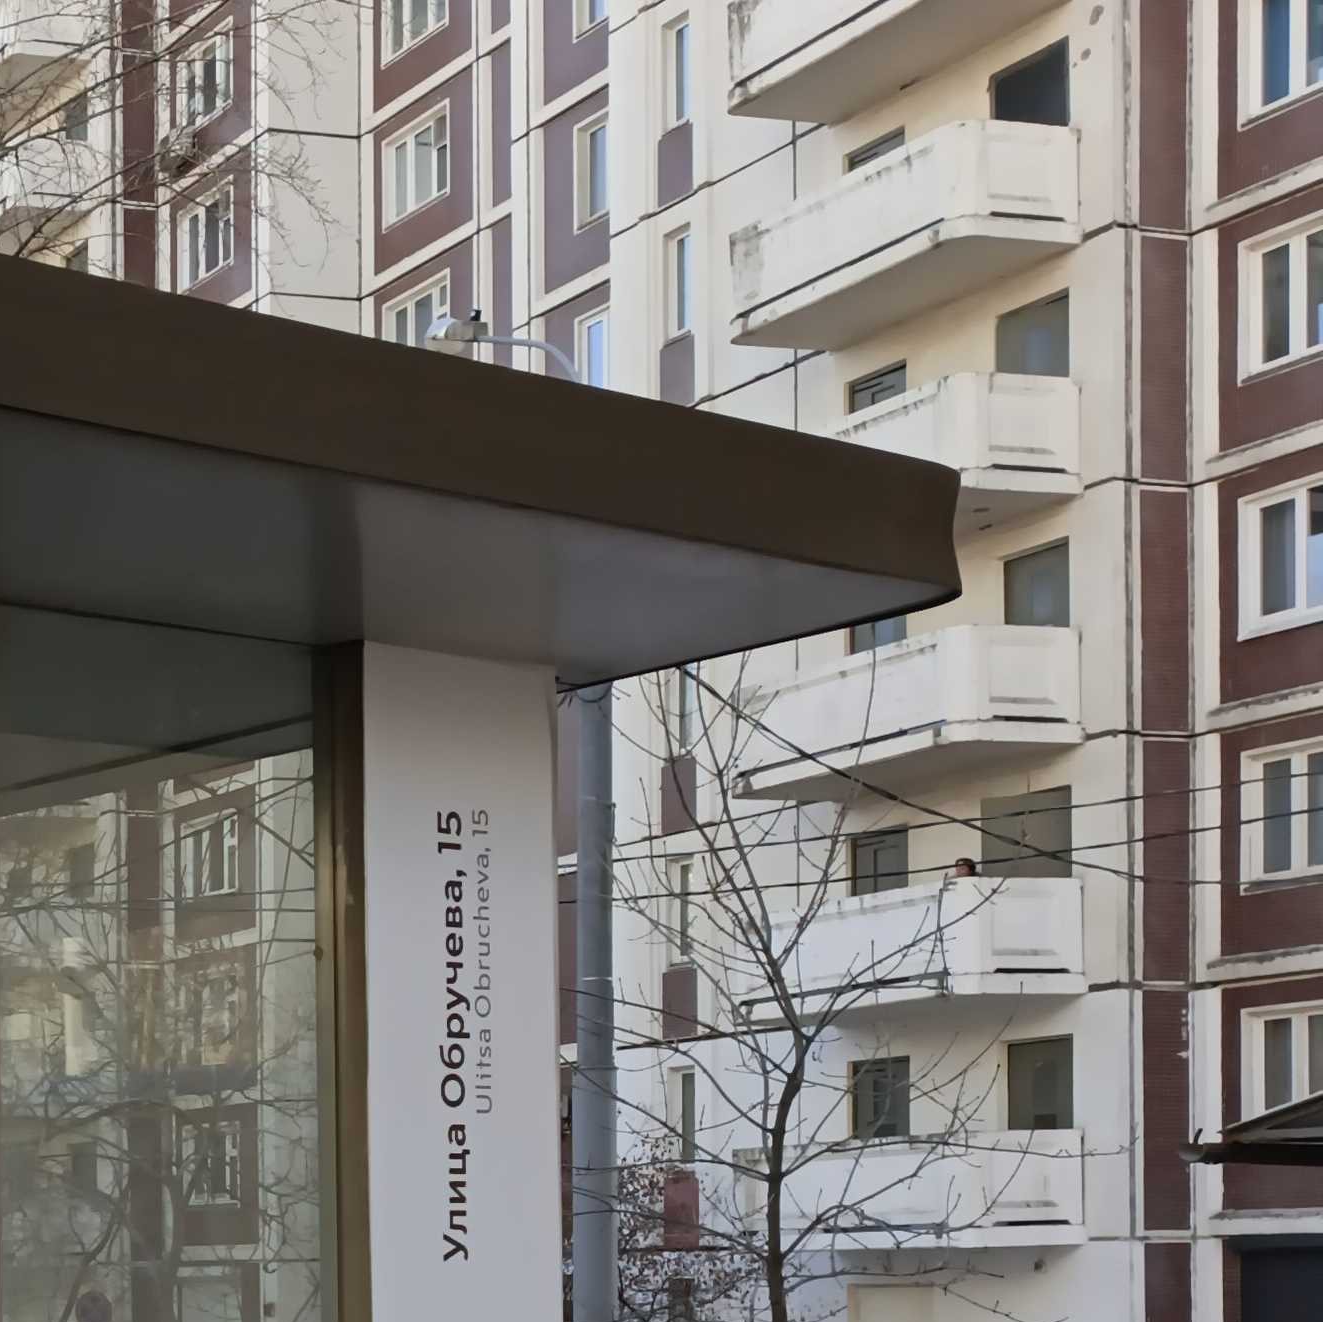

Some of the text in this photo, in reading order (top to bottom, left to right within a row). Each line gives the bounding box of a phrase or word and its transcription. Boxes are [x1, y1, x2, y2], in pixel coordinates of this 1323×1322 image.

[437, 811, 472, 1262] Улица Обручева, 15
[471, 808, 493, 1115] Ulitsa Obrucheva, 15
